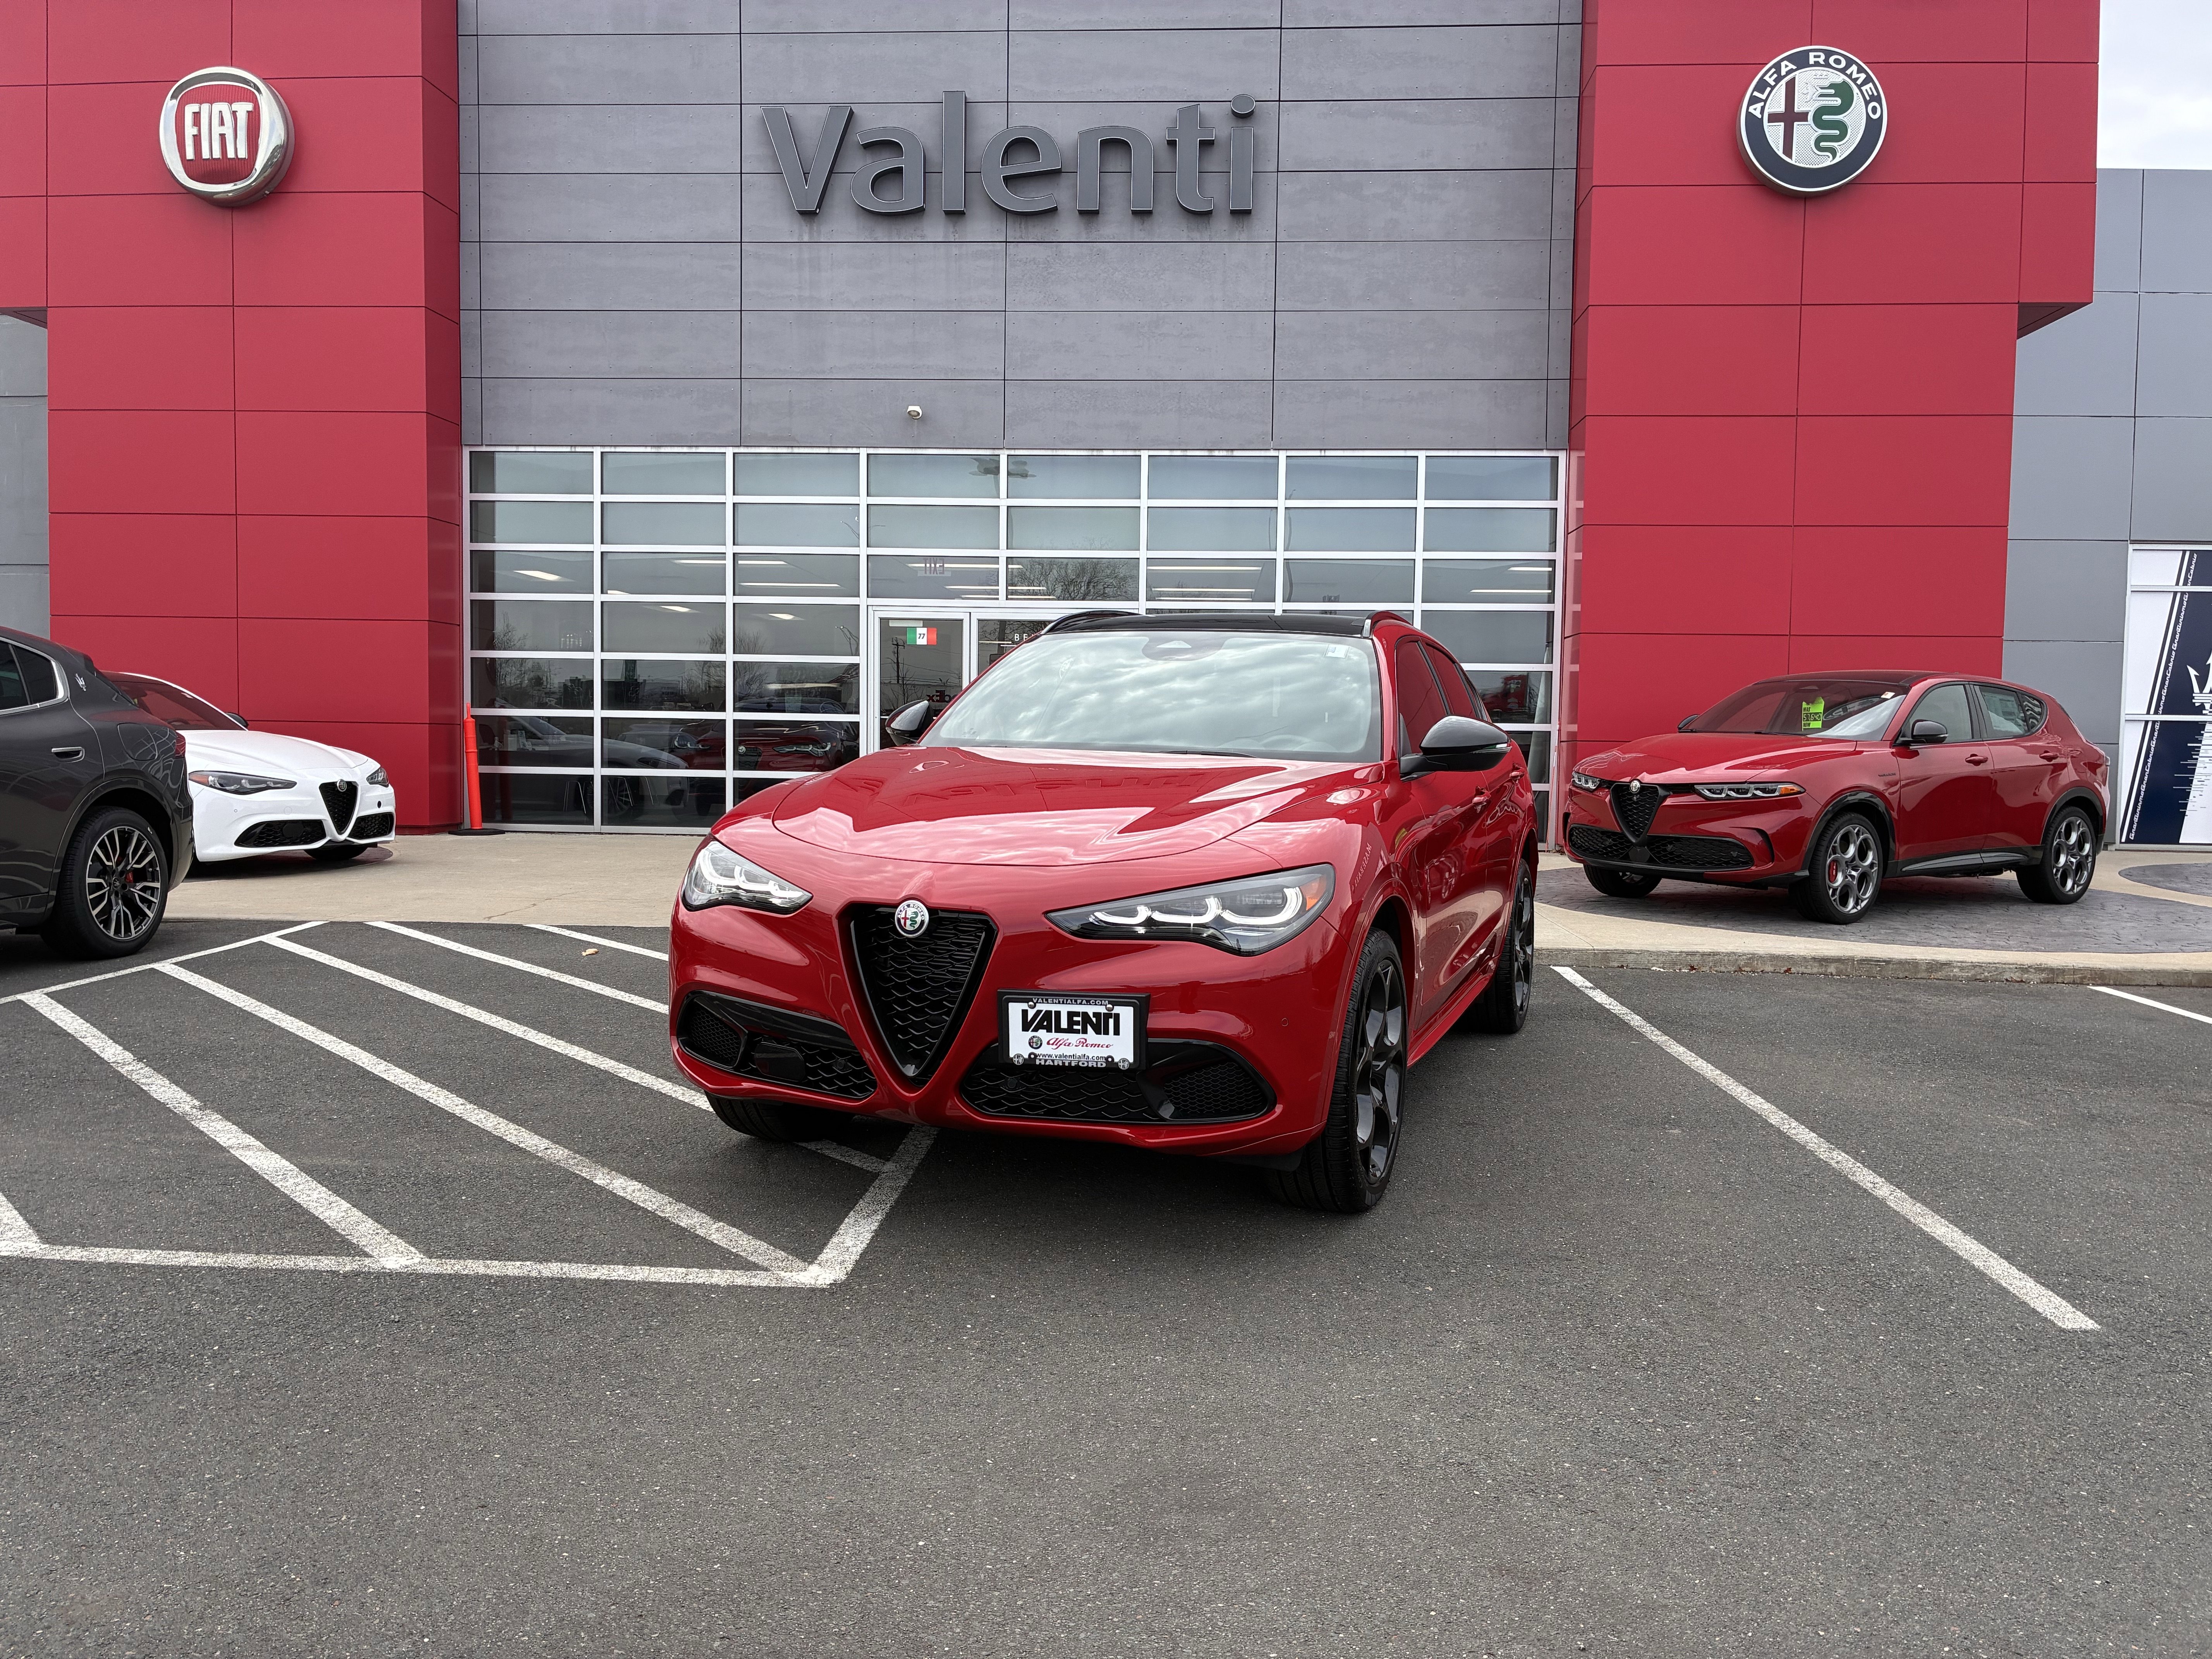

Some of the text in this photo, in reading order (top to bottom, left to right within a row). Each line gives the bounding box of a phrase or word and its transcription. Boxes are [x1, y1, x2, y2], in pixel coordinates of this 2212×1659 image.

[1748, 52, 1881, 119] ALFA ROMEO
[184, 102, 254, 161] FIAT
[759, 90, 1256, 216] Valenti
[898, 905, 908, 918] ALFA
[1021, 1009, 1120, 1036] VALENTI
[1046, 1037, 1073, 1049] Alfa
[1075, 1037, 1114, 1048] Romeo
[1036, 1053, 1106, 1061] www.valentialfa.com
[1036, 1059, 1106, 1068] HARTFORD
